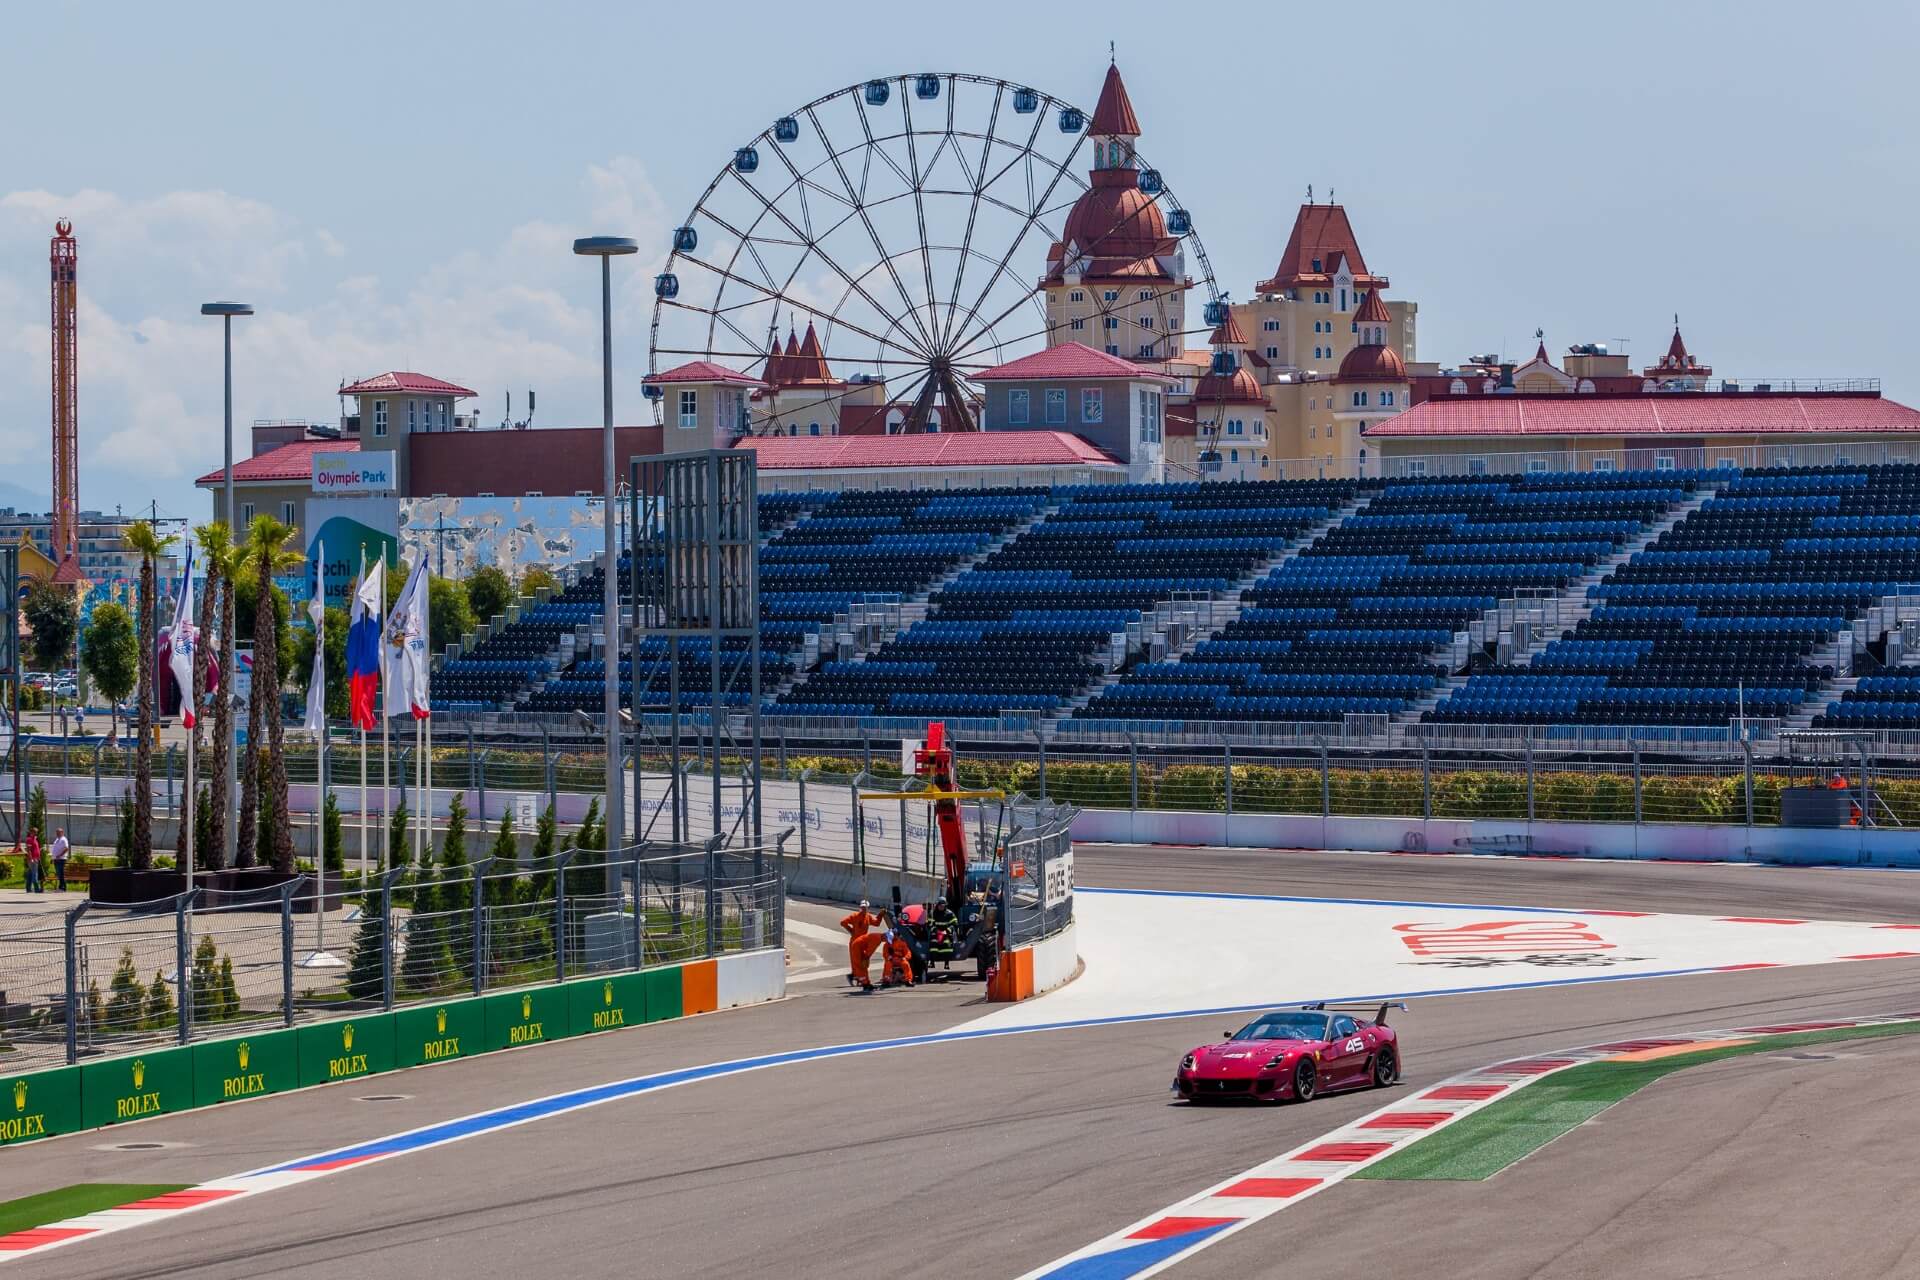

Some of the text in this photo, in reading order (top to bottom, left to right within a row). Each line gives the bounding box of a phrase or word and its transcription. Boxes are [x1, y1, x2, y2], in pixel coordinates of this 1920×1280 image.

[318, 470, 386, 487] Olympic Park
[312, 559, 351, 577] Sochi
[593, 1008, 624, 1028] ROLEX
[510, 1023, 543, 1043] ROLEX
[424, 1038, 459, 1059] ROLEX
[1345, 1037, 1364, 1053] 45
[330, 1054, 367, 1077] ROLEX
[224, 1073, 264, 1097] ROLEX
[117, 1092, 160, 1118] ROLEX
[0, 1114, 44, 1140] ROLEX
